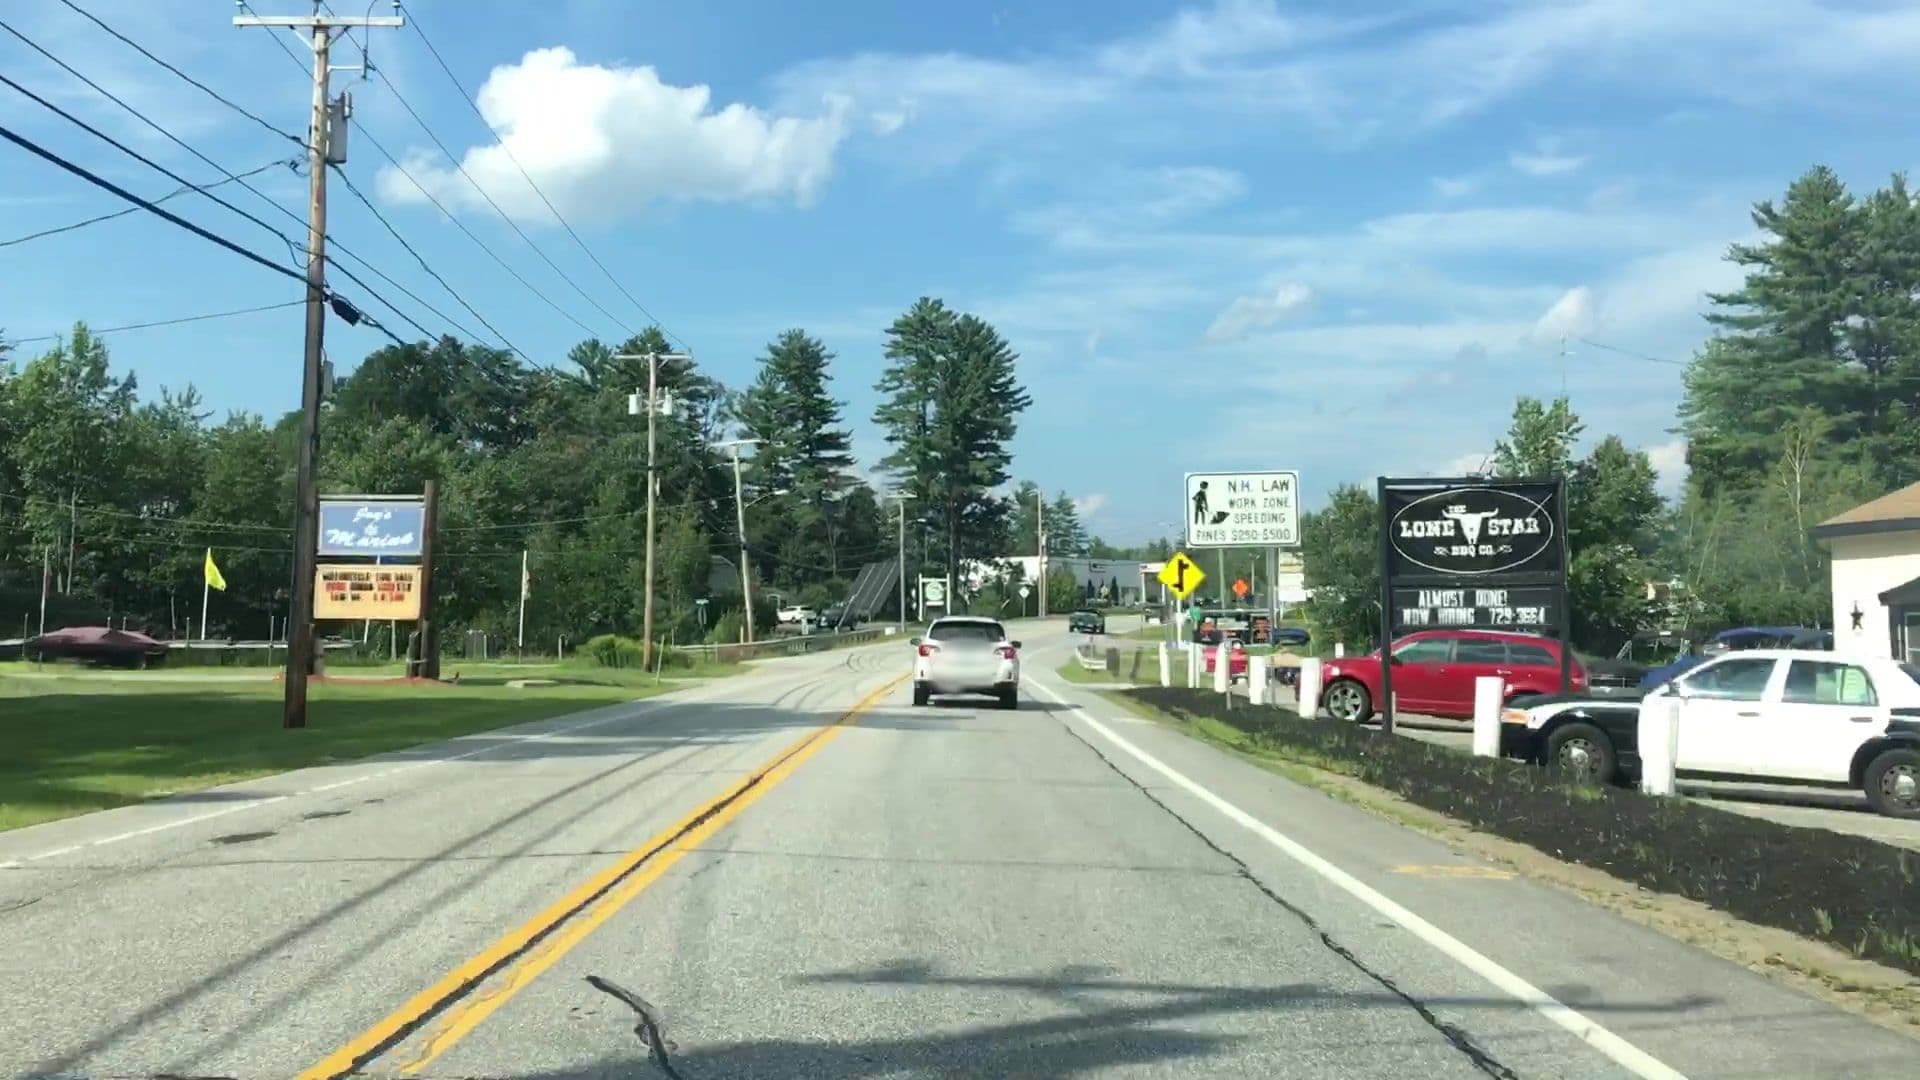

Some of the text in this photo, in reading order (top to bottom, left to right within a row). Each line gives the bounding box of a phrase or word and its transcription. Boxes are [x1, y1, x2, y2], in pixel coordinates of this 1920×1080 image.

[1262, 480, 1289, 492] LAW
[1229, 497, 1291, 509] WORK ZONE
[1234, 512, 1286, 524] SPEEDING
[1400, 518, 1540, 538] LONE STAR
[1196, 530, 1226, 541] FINES
[1451, 545, 1476, 557] BBQ
[1418, 590, 1507, 607] ALMOST DONE!
[1403, 608, 1430, 625] NOW
[1438, 608, 1475, 624] HIRING
